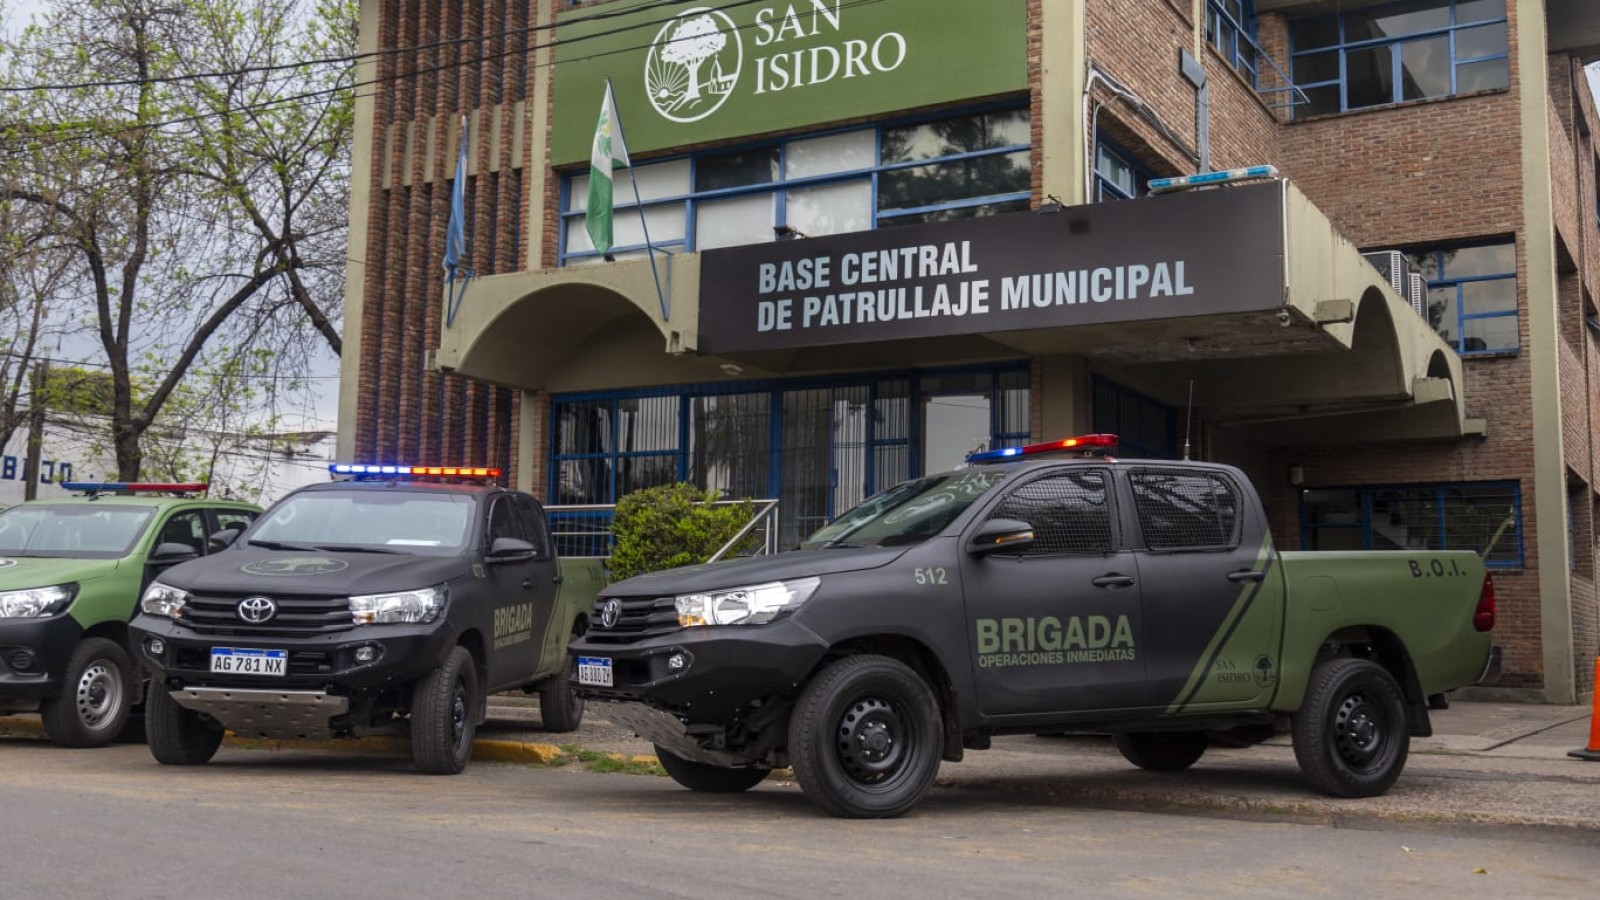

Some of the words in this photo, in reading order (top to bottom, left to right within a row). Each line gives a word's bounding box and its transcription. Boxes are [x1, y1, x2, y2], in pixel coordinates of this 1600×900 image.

[755, 0, 840, 46] SAN
[752, 32, 906, 94] ISIDRO
[759, 256, 830, 294] BASE
[841, 240, 978, 286] CENTRAL
[757, 299, 792, 332] DE
[802, 279, 989, 328] PATRULLAJE
[1000, 260, 1194, 310] MUNICIPAL
[915, 568, 948, 585] 512
[1408, 559, 1467, 577] B.O.I.
[493, 602, 532, 639] BRIGADA
[976, 615, 1135, 654] BRIGADA
[214, 656, 232, 671] AG
[236, 657, 261, 672] 781
[265, 658, 282, 673] NX
[978, 651, 1063, 668] OPERACIONES
[1067, 648, 1135, 664] INMEDIATAS
